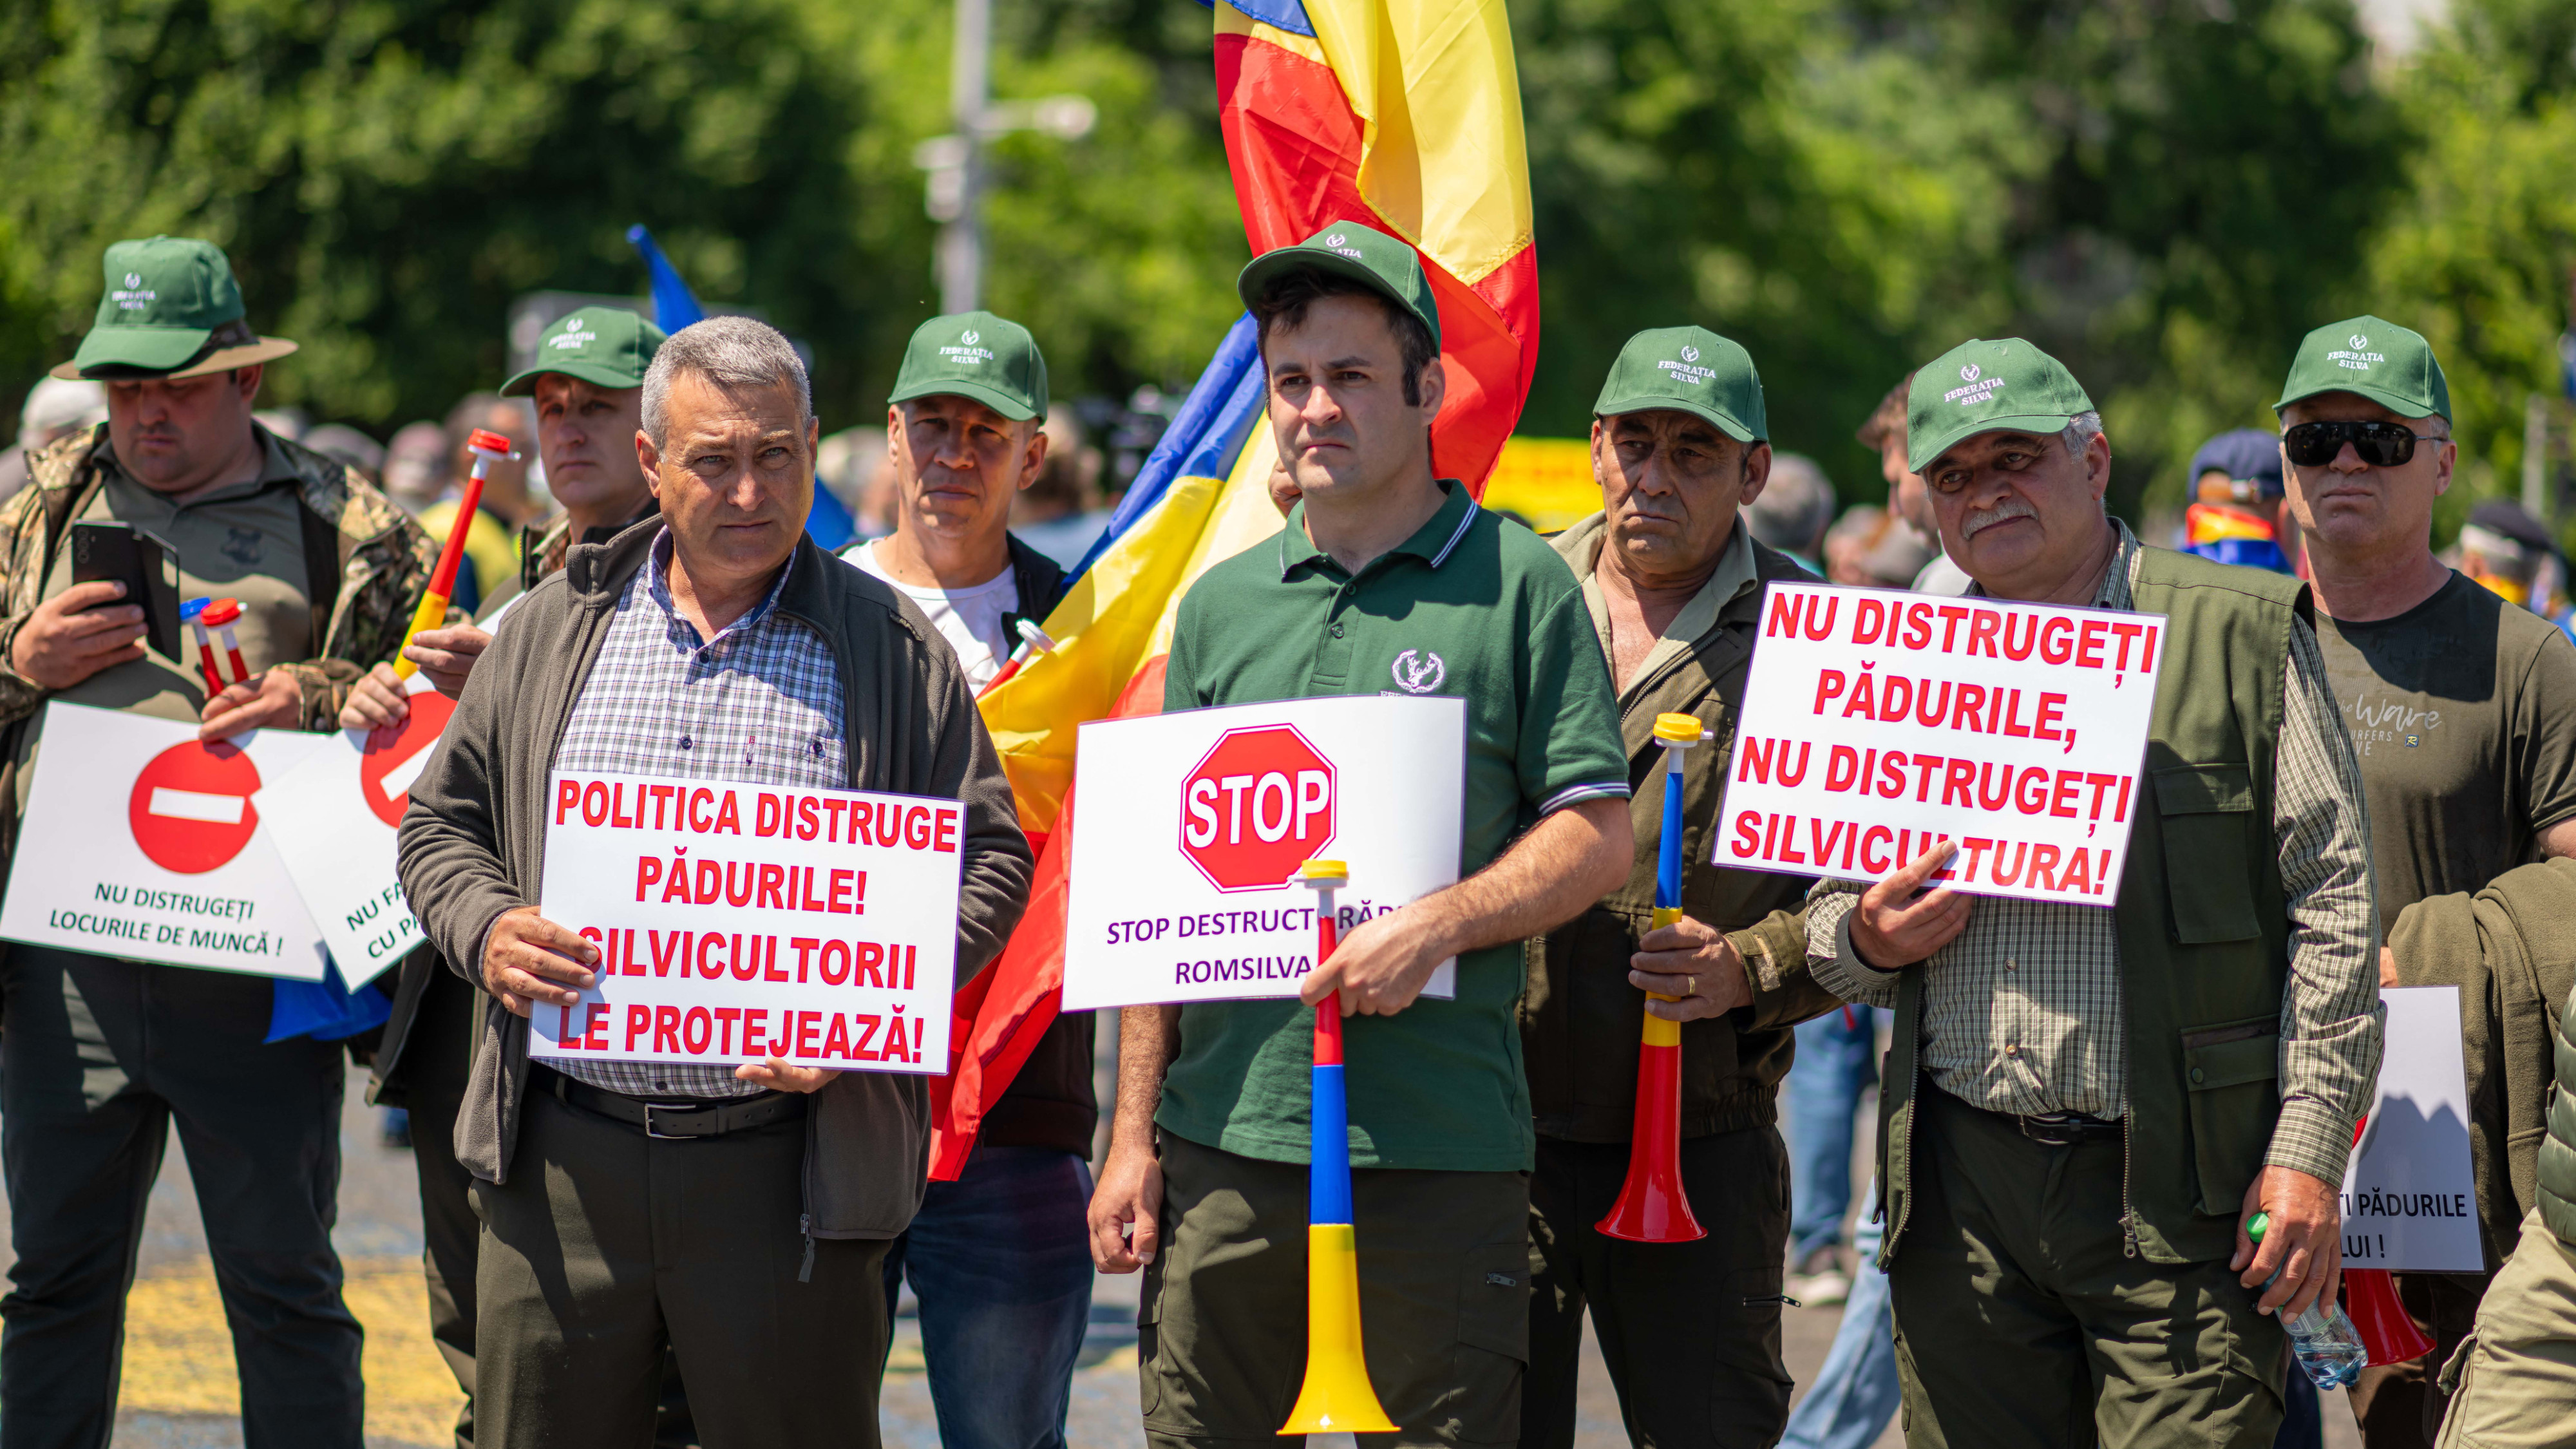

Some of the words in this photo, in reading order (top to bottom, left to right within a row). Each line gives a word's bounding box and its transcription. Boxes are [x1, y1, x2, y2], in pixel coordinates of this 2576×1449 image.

[951, 355, 980, 364] SILVA
[1658, 360, 1716, 379] FEDERAȚIA
[2327, 350, 2384, 363] FEDERAȚIA
[2338, 359, 2369, 370] SILVA
[1670, 370, 1700, 384] SILVA
[1944, 377, 2005, 402] FEDERAȚIA
[1962, 390, 1993, 406] SILVA
[1766, 592, 1839, 641] NU
[1852, 598, 2158, 689] DISTRUGEȚI
[1813, 661, 2078, 755] PĂDURILE,
[2356, 694, 2442, 732] Wave
[2351, 730, 2392, 741] URFERS
[1738, 736, 1812, 788] NU
[1824, 744, 2132, 838] DISTRUGEȚI
[556, 779, 741, 835] POLITICA
[755, 792, 958, 853] DISTRUGE
[1186, 770, 1330, 848] STOP
[636, 846, 867, 915] PĂDURILE!
[94, 882, 129, 904] NU
[133, 888, 255, 924] DISTRUGEȚI
[346, 899, 379, 932] NU
[49, 909, 150, 942] LOCURILE
[156, 925, 184, 945] DE
[189, 928, 269, 956] MUNCĂ
[276, 937, 283, 957] !
[368, 929, 395, 958] CU
[1106, 919, 1170, 945] STOP
[574, 926, 916, 990] SILVICULTORII
[1175, 956, 1312, 985] ROMSILVA
[558, 1003, 611, 1051] LE
[625, 1003, 924, 1064] PROTEJEAZĂ!
[2358, 1187, 2467, 1217] PĂDURILE
[2378, 1234, 2385, 1258] !
